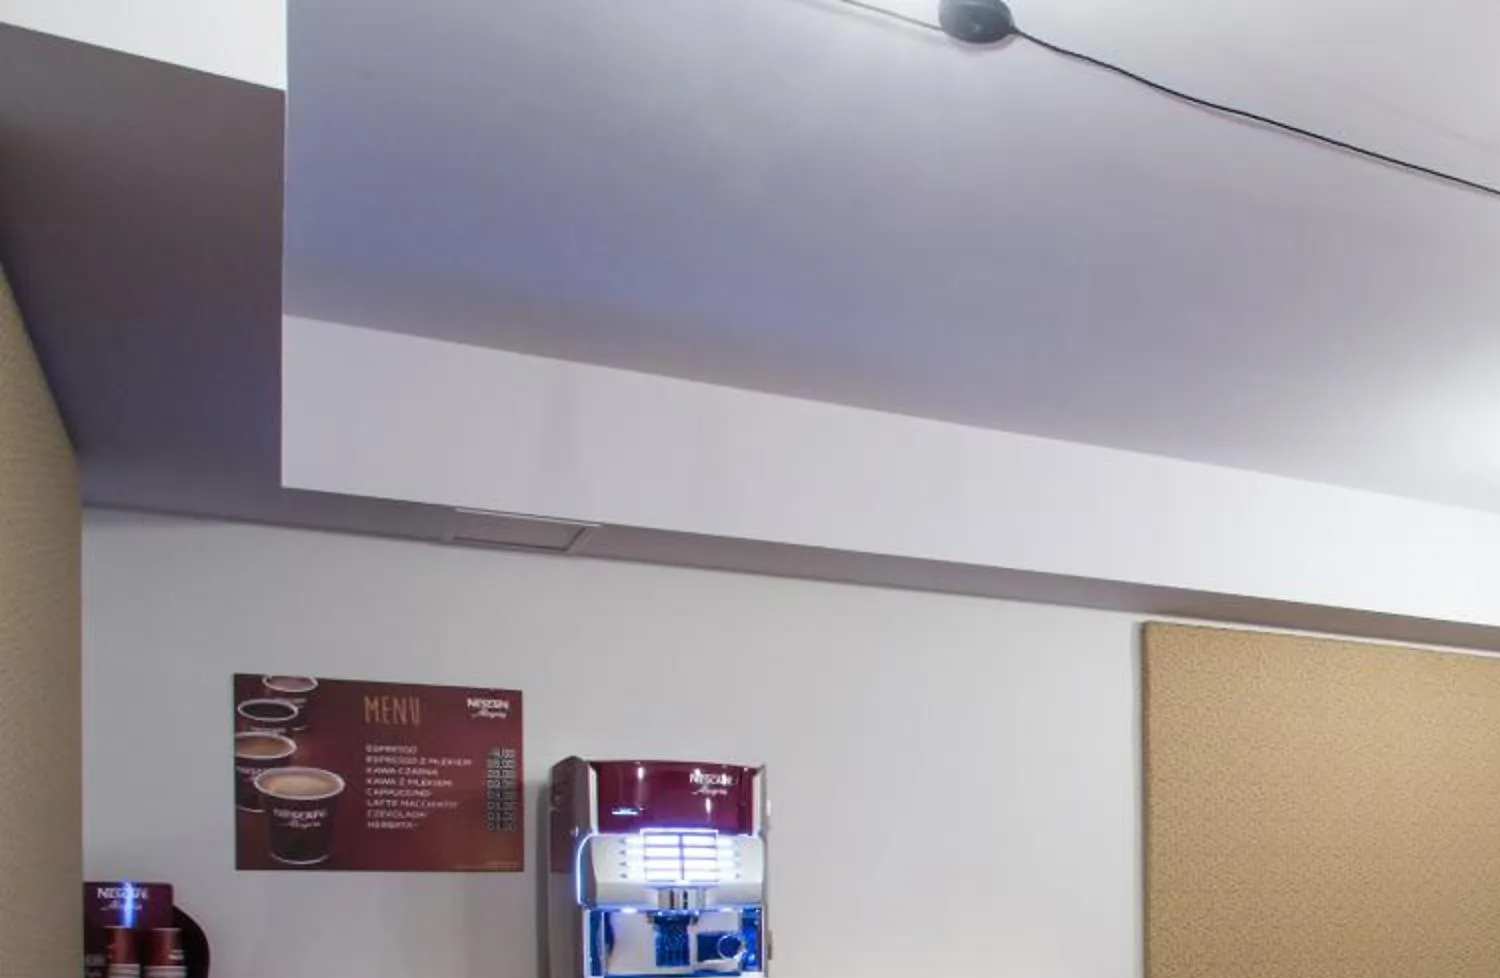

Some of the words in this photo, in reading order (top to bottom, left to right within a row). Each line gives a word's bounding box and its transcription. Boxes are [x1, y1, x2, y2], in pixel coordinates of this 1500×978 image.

[364, 695, 421, 725] MENU
[365, 755, 418, 766] ESPRESSO
[365, 766, 397, 776] KAWA
[365, 777, 397, 786] KAWA
